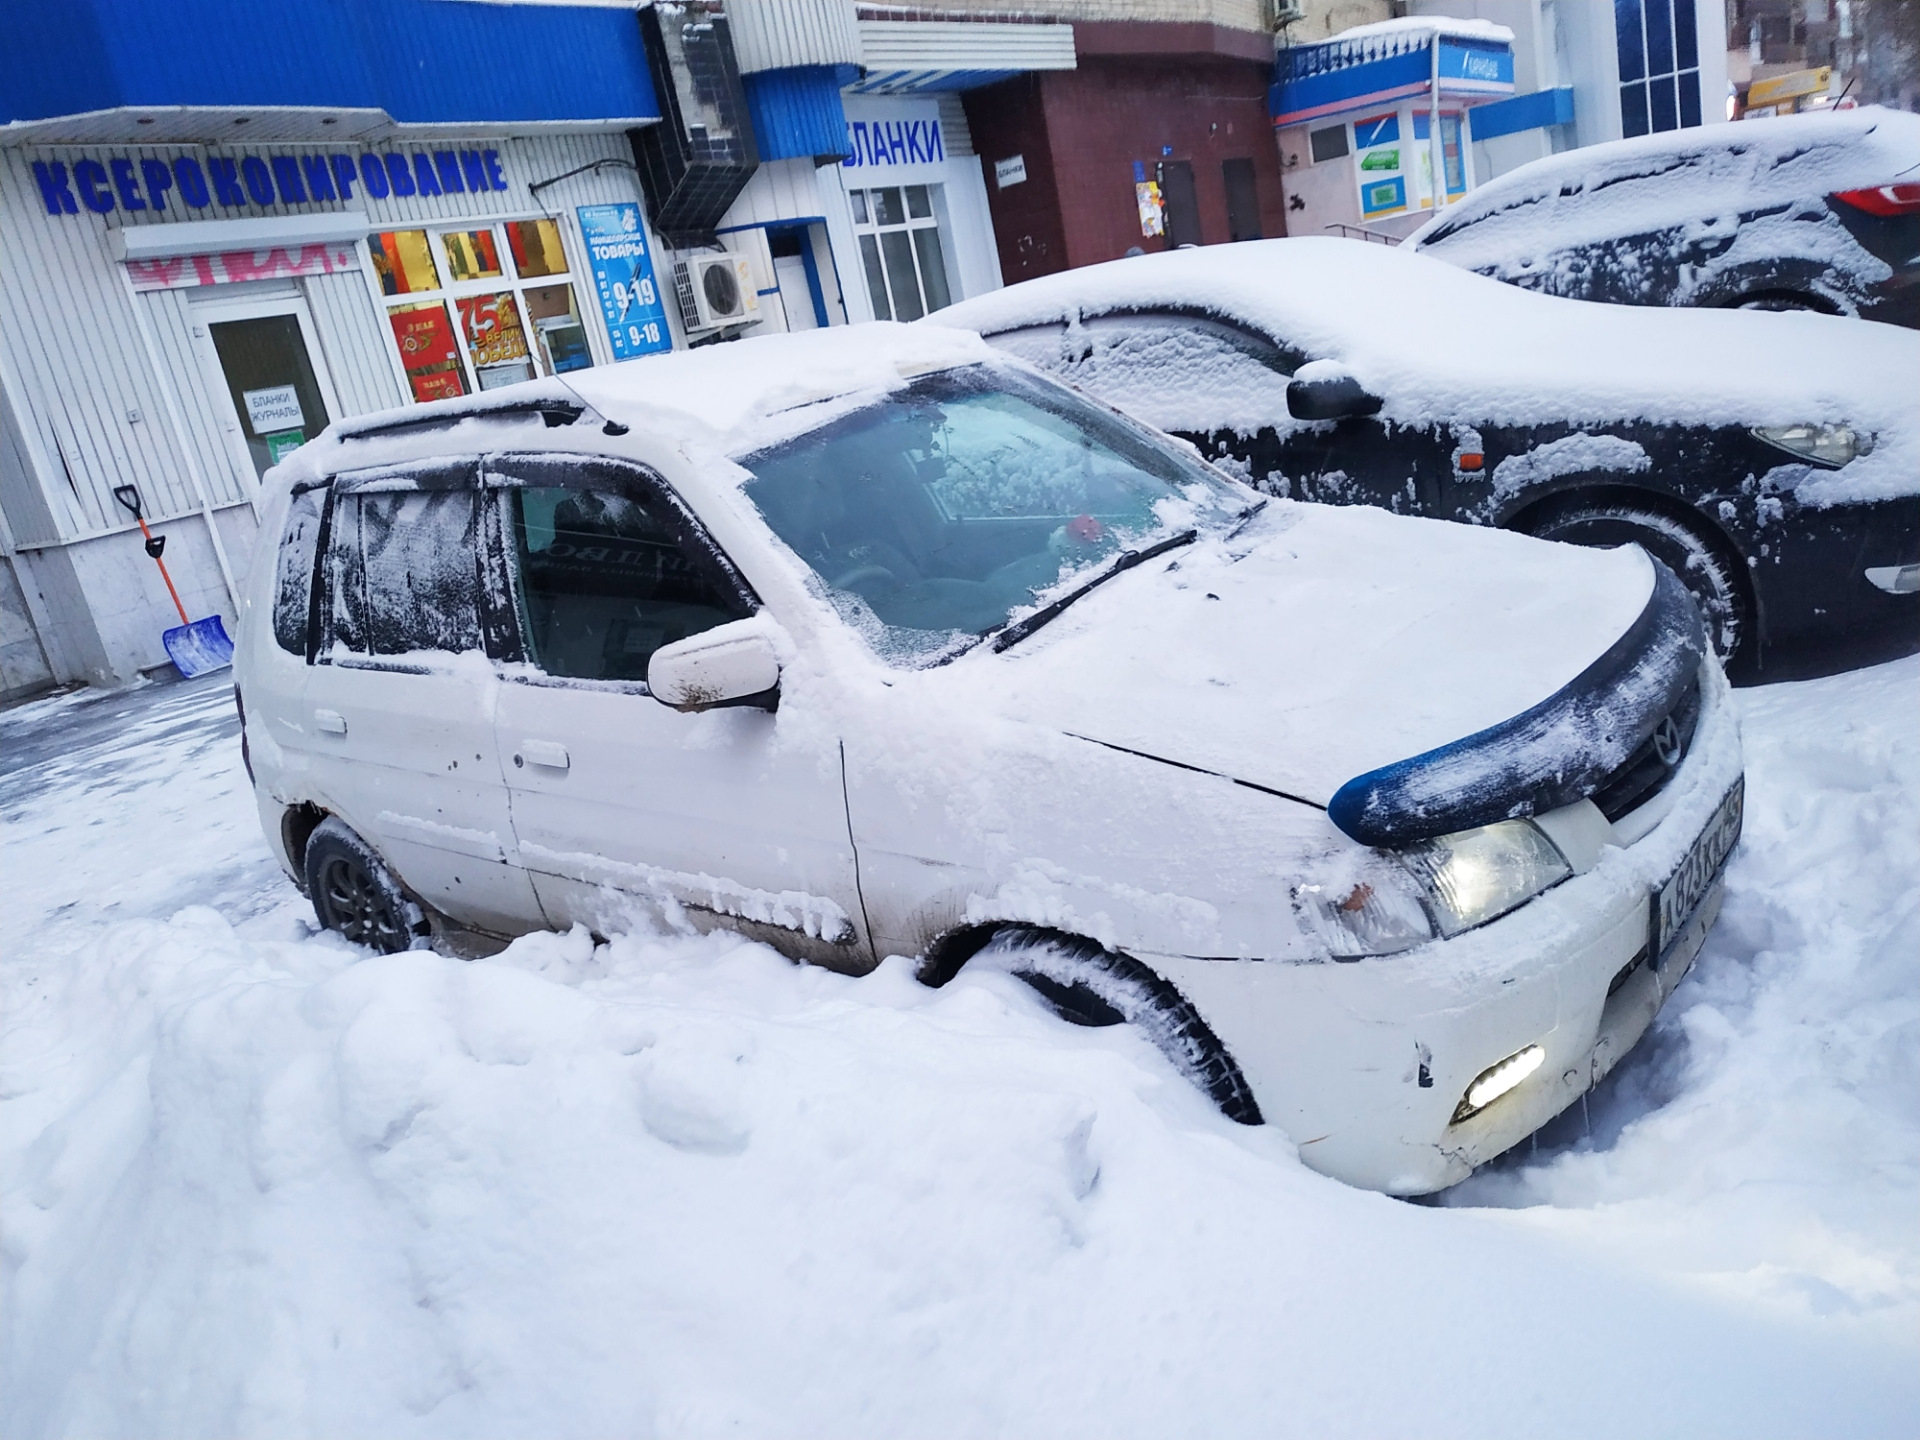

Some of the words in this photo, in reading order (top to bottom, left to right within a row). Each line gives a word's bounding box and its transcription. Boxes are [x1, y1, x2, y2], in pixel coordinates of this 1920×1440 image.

[32, 149, 507, 215] КСЕРОКОПИРОВАНИЕ
[592, 242, 645, 261] ТОВАРЫ
[613, 278, 656, 310] 9-19
[455, 294, 502, 348] 75
[629, 322, 660, 346] 9-18
[252, 393, 291, 408] БЛАНКИ
[250, 406, 300, 422] ЖУРНАЛЫ
